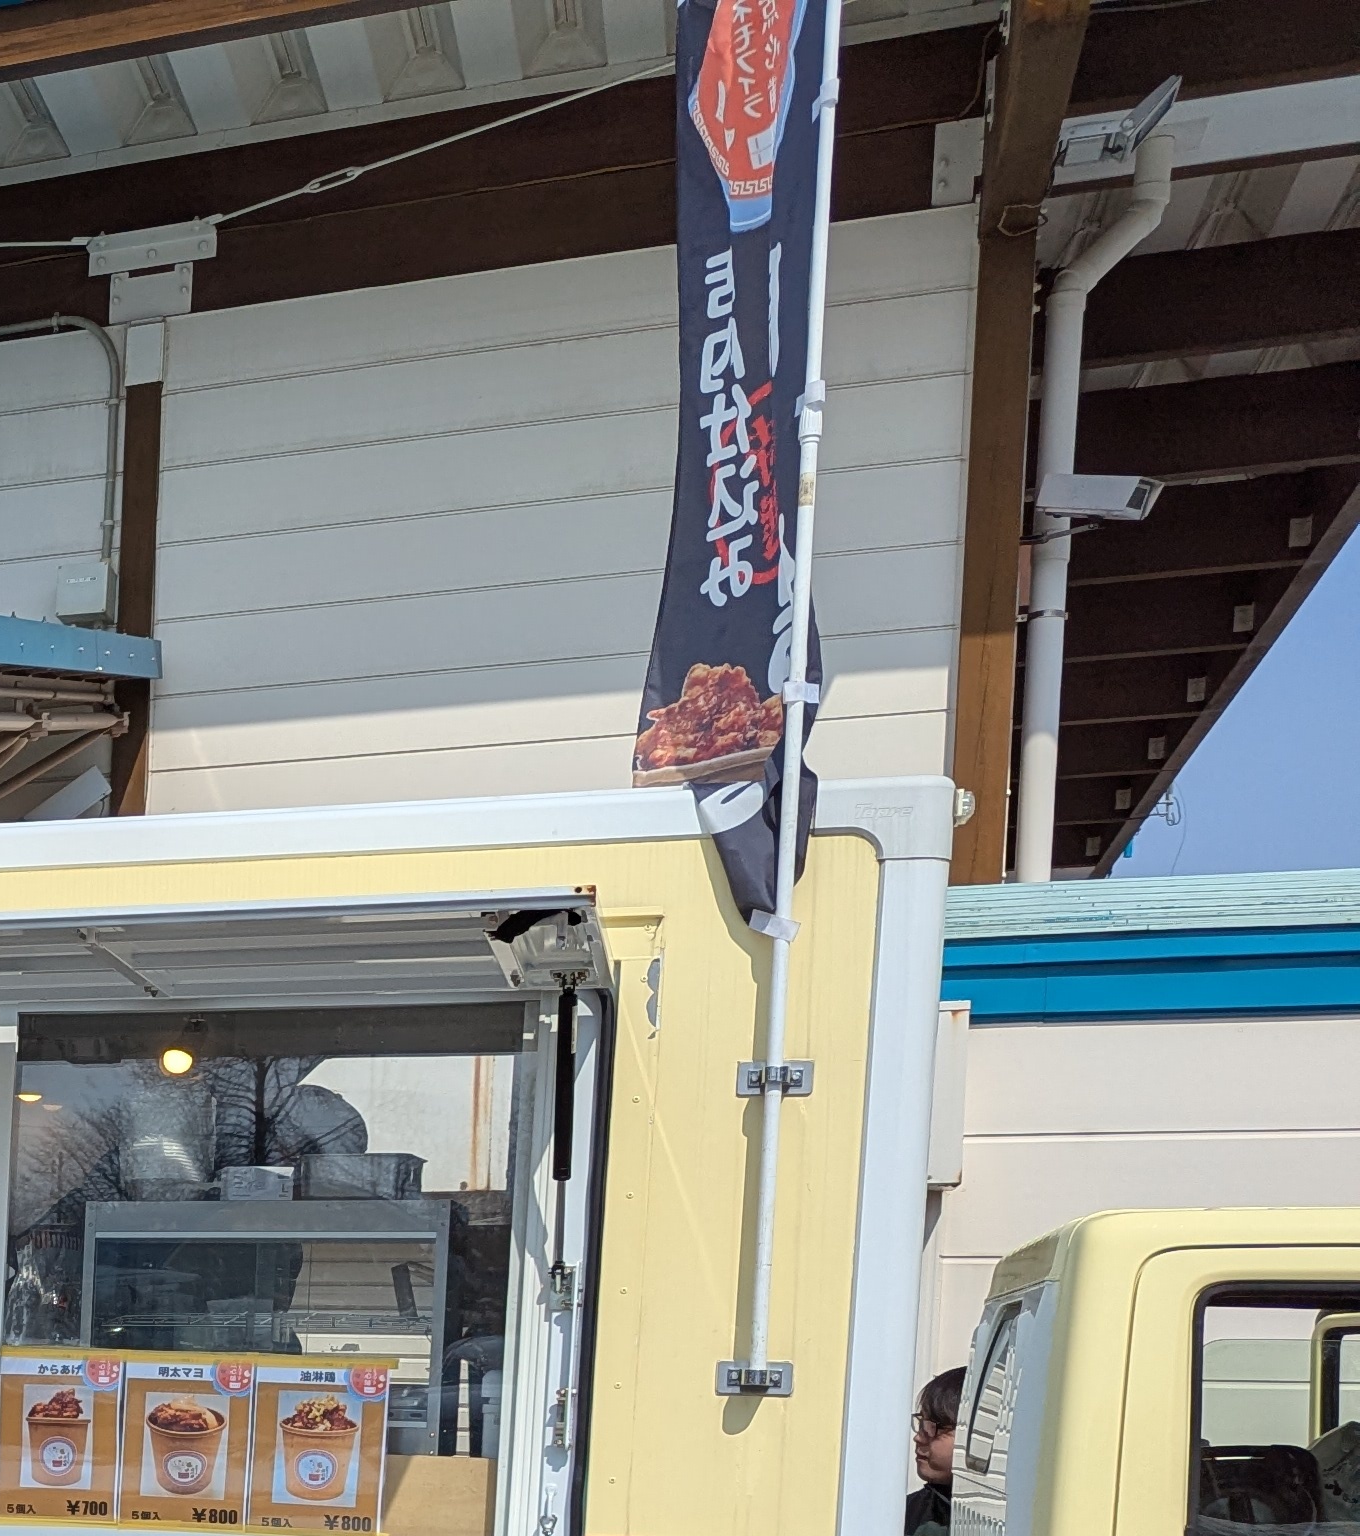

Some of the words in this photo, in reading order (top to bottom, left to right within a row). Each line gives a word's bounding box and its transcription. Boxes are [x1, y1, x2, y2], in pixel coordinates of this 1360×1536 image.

[38, 1363, 83, 1375] からあげ
[158, 1366, 204, 1378] 明太マヨ
[300, 1370, 336, 1382] 油淋鶏
[7, 1503, 37, 1515] 5個入
[66, 1499, 108, 1516] ¥700
[131, 1510, 161, 1521] 5個入
[192, 1507, 238, 1525] ¥800
[261, 1516, 292, 1528] 5個入
[324, 1514, 372, 1532] ¥800
